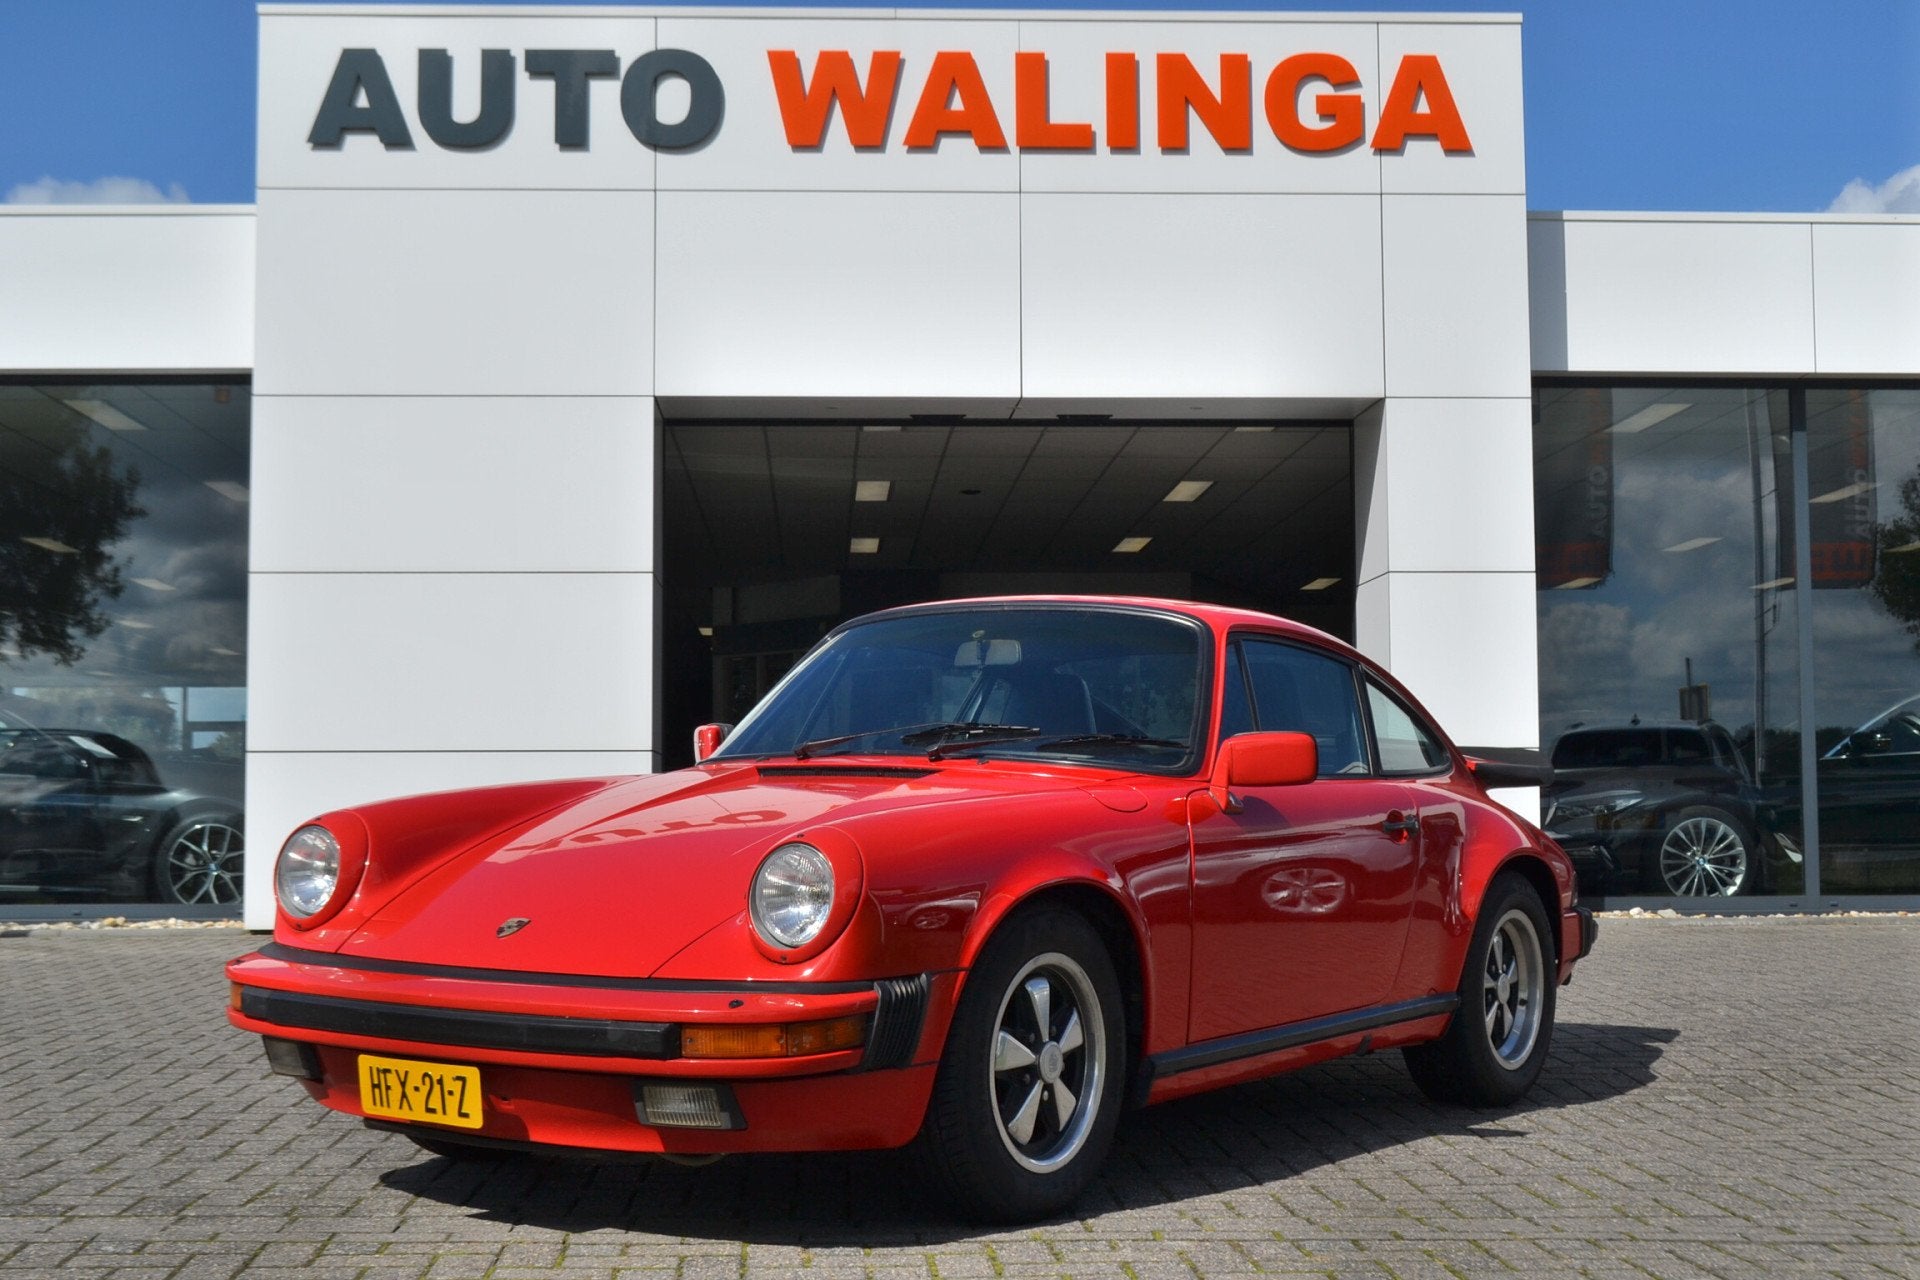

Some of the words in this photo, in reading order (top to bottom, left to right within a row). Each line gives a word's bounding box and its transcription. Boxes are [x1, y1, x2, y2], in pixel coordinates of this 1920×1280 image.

[307, 48, 725, 149] AUTO
[767, 49, 1474, 154] WALINGA
[369, 1065, 470, 1118] HFX-21-Z
